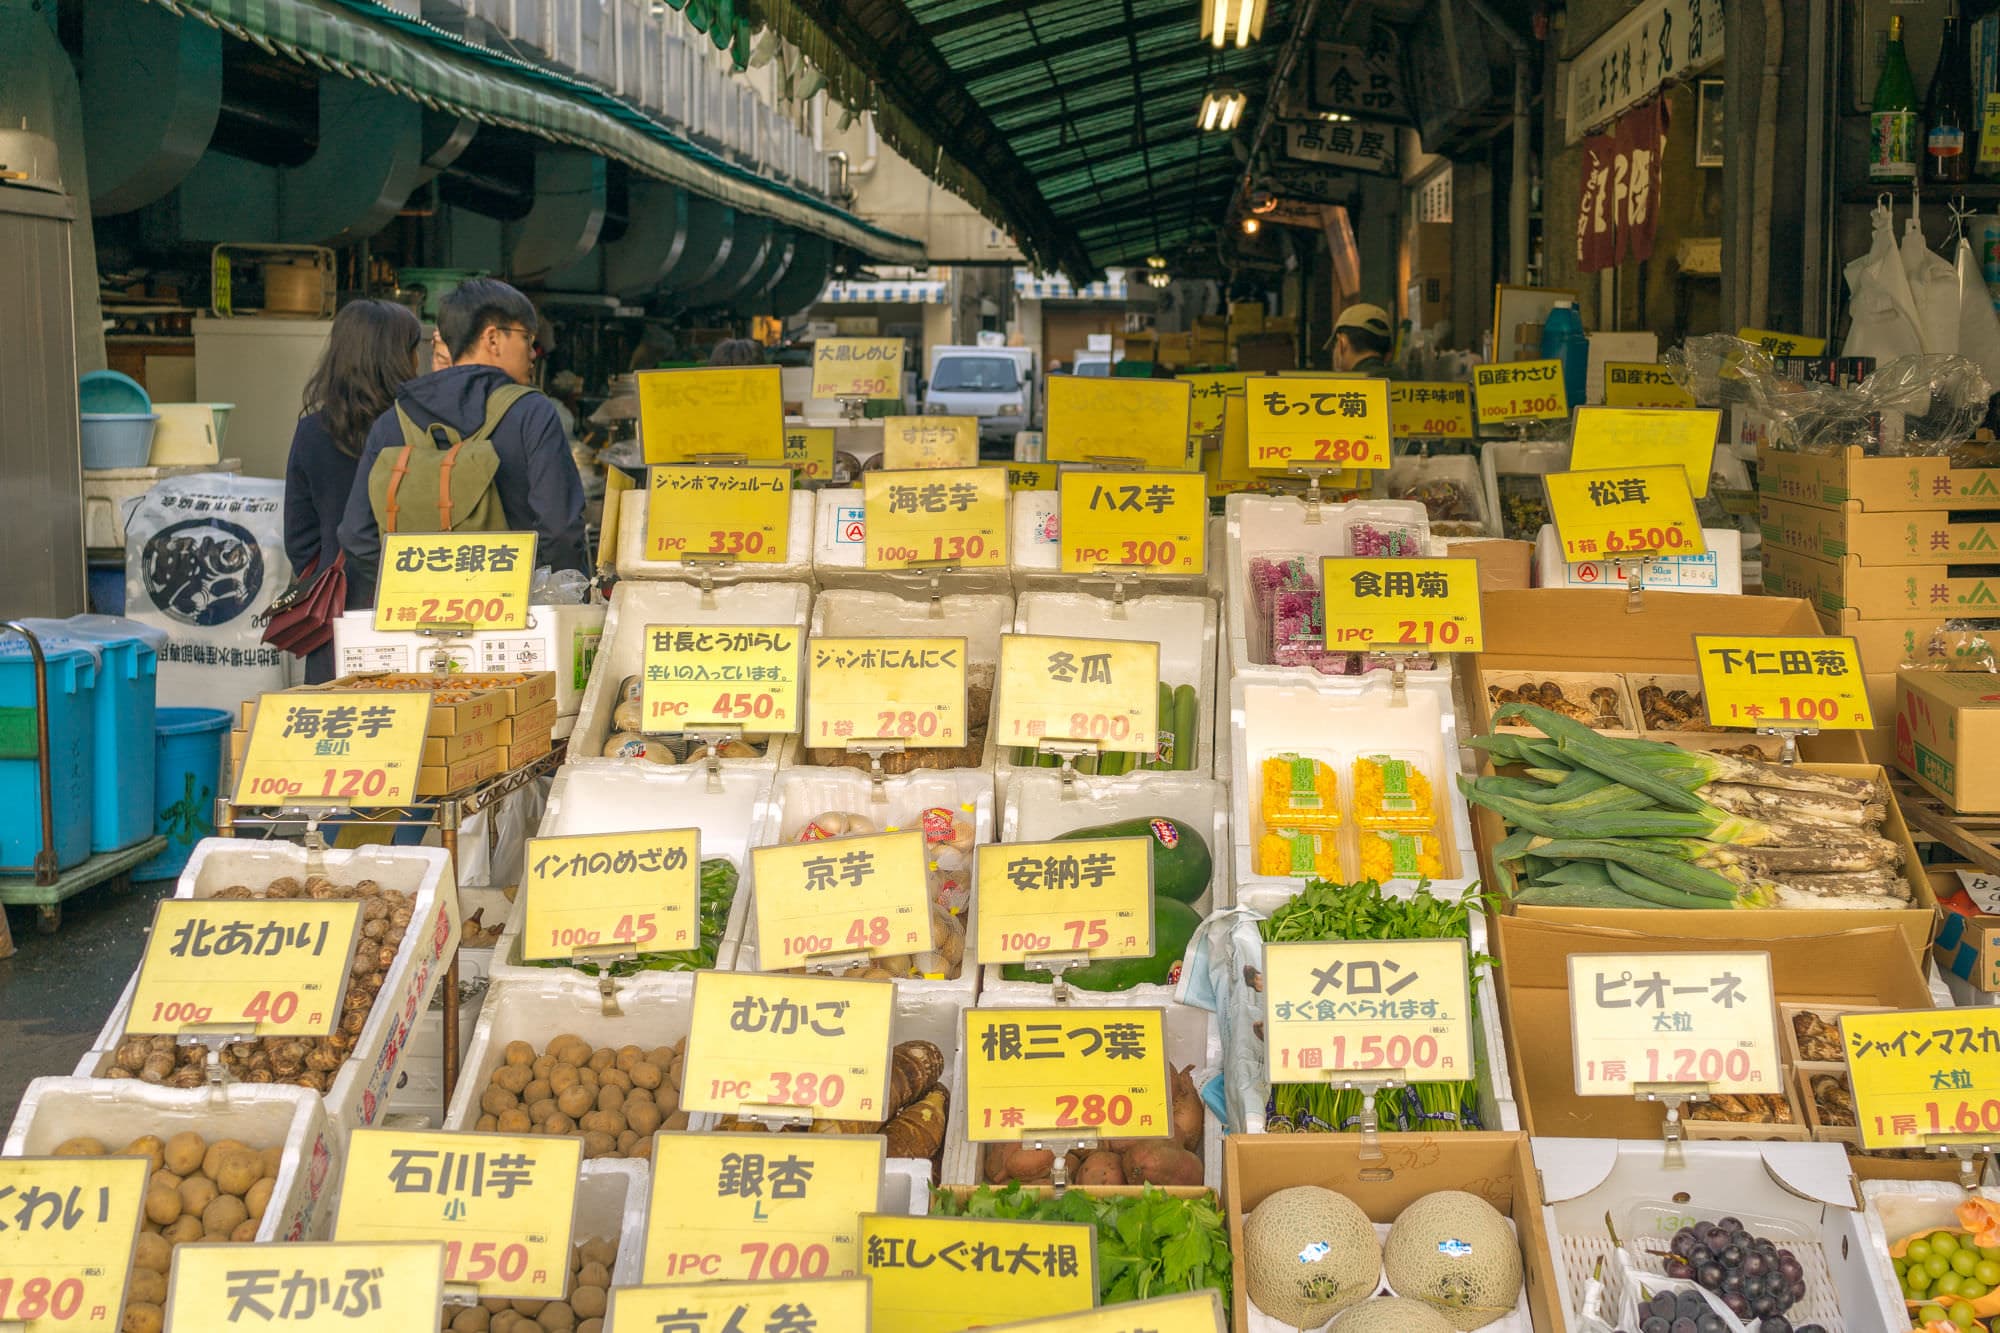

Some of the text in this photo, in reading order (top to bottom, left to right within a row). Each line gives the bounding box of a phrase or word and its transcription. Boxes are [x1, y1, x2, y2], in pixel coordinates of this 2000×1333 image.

[818, 344, 898, 362] 大黒しめじ
[1478, 365, 1557, 386] 国産わさび
[1264, 391, 1367, 417] もって菊
[1258, 446, 1292, 460] 1PC
[656, 475, 785, 493] ジャンボマッシュルーム
[1588, 478, 1650, 507] 松茸
[889, 482, 978, 514] 海老芋
[1090, 485, 1175, 513] ハス芋
[657, 537, 687, 552] 1PC
[877, 547, 918, 563] 100g
[1075, 548, 1109, 562] 1PC
[395, 544, 519, 573] むき銀杏
[1350, 571, 1448, 599] 食用菊
[653, 631, 791, 652] 甘長とうがらし
[1337, 628, 1374, 642] 1PC
[816, 649, 958, 669] ジャンボにんにく
[1048, 652, 1113, 685] 冬瓜
[1709, 648, 1848, 676] 下仁田葱
[648, 665, 787, 681] 辛いの入っています。
[652, 701, 689, 717] 1PC
[282, 706, 396, 739] 海老芋
[314, 740, 350, 756] 極小
[250, 777, 303, 795] 100g
[160, 771, 212, 845] 水
[534, 847, 688, 879] インカのめざめ
[803, 851, 875, 891] 京芋
[1008, 853, 1116, 891] 安納芋
[170, 919, 329, 957] 北あかり
[551, 928, 600, 947] 100g
[783, 935, 832, 956] 100g
[1001, 933, 1051, 952] 100g
[1310, 960, 1419, 996] メロン
[1595, 971, 1748, 1009] ピオーネ
[152, 1002, 212, 1022] 100g
[731, 995, 850, 1037] むかご
[1275, 999, 1448, 1021] すぐ食べられます。
[1653, 1012, 1694, 1032] 大粒
[981, 1023, 1146, 1061] 根三つ葉
[1852, 1026, 2000, 1059] シャインマスカ
[711, 1080, 751, 1100] 1PC
[1930, 1069, 1974, 1089] 大粒
[388, 1149, 536, 1199] 石川芋
[718, 1153, 814, 1199] 銀杏
[443, 1198, 466, 1221] 小
[753, 1200, 768, 1219] L
[667, 1254, 721, 1277] 1PC
[867, 1234, 1079, 1278] 紅しぐれ大根
[226, 1267, 384, 1323] 天かぶ
